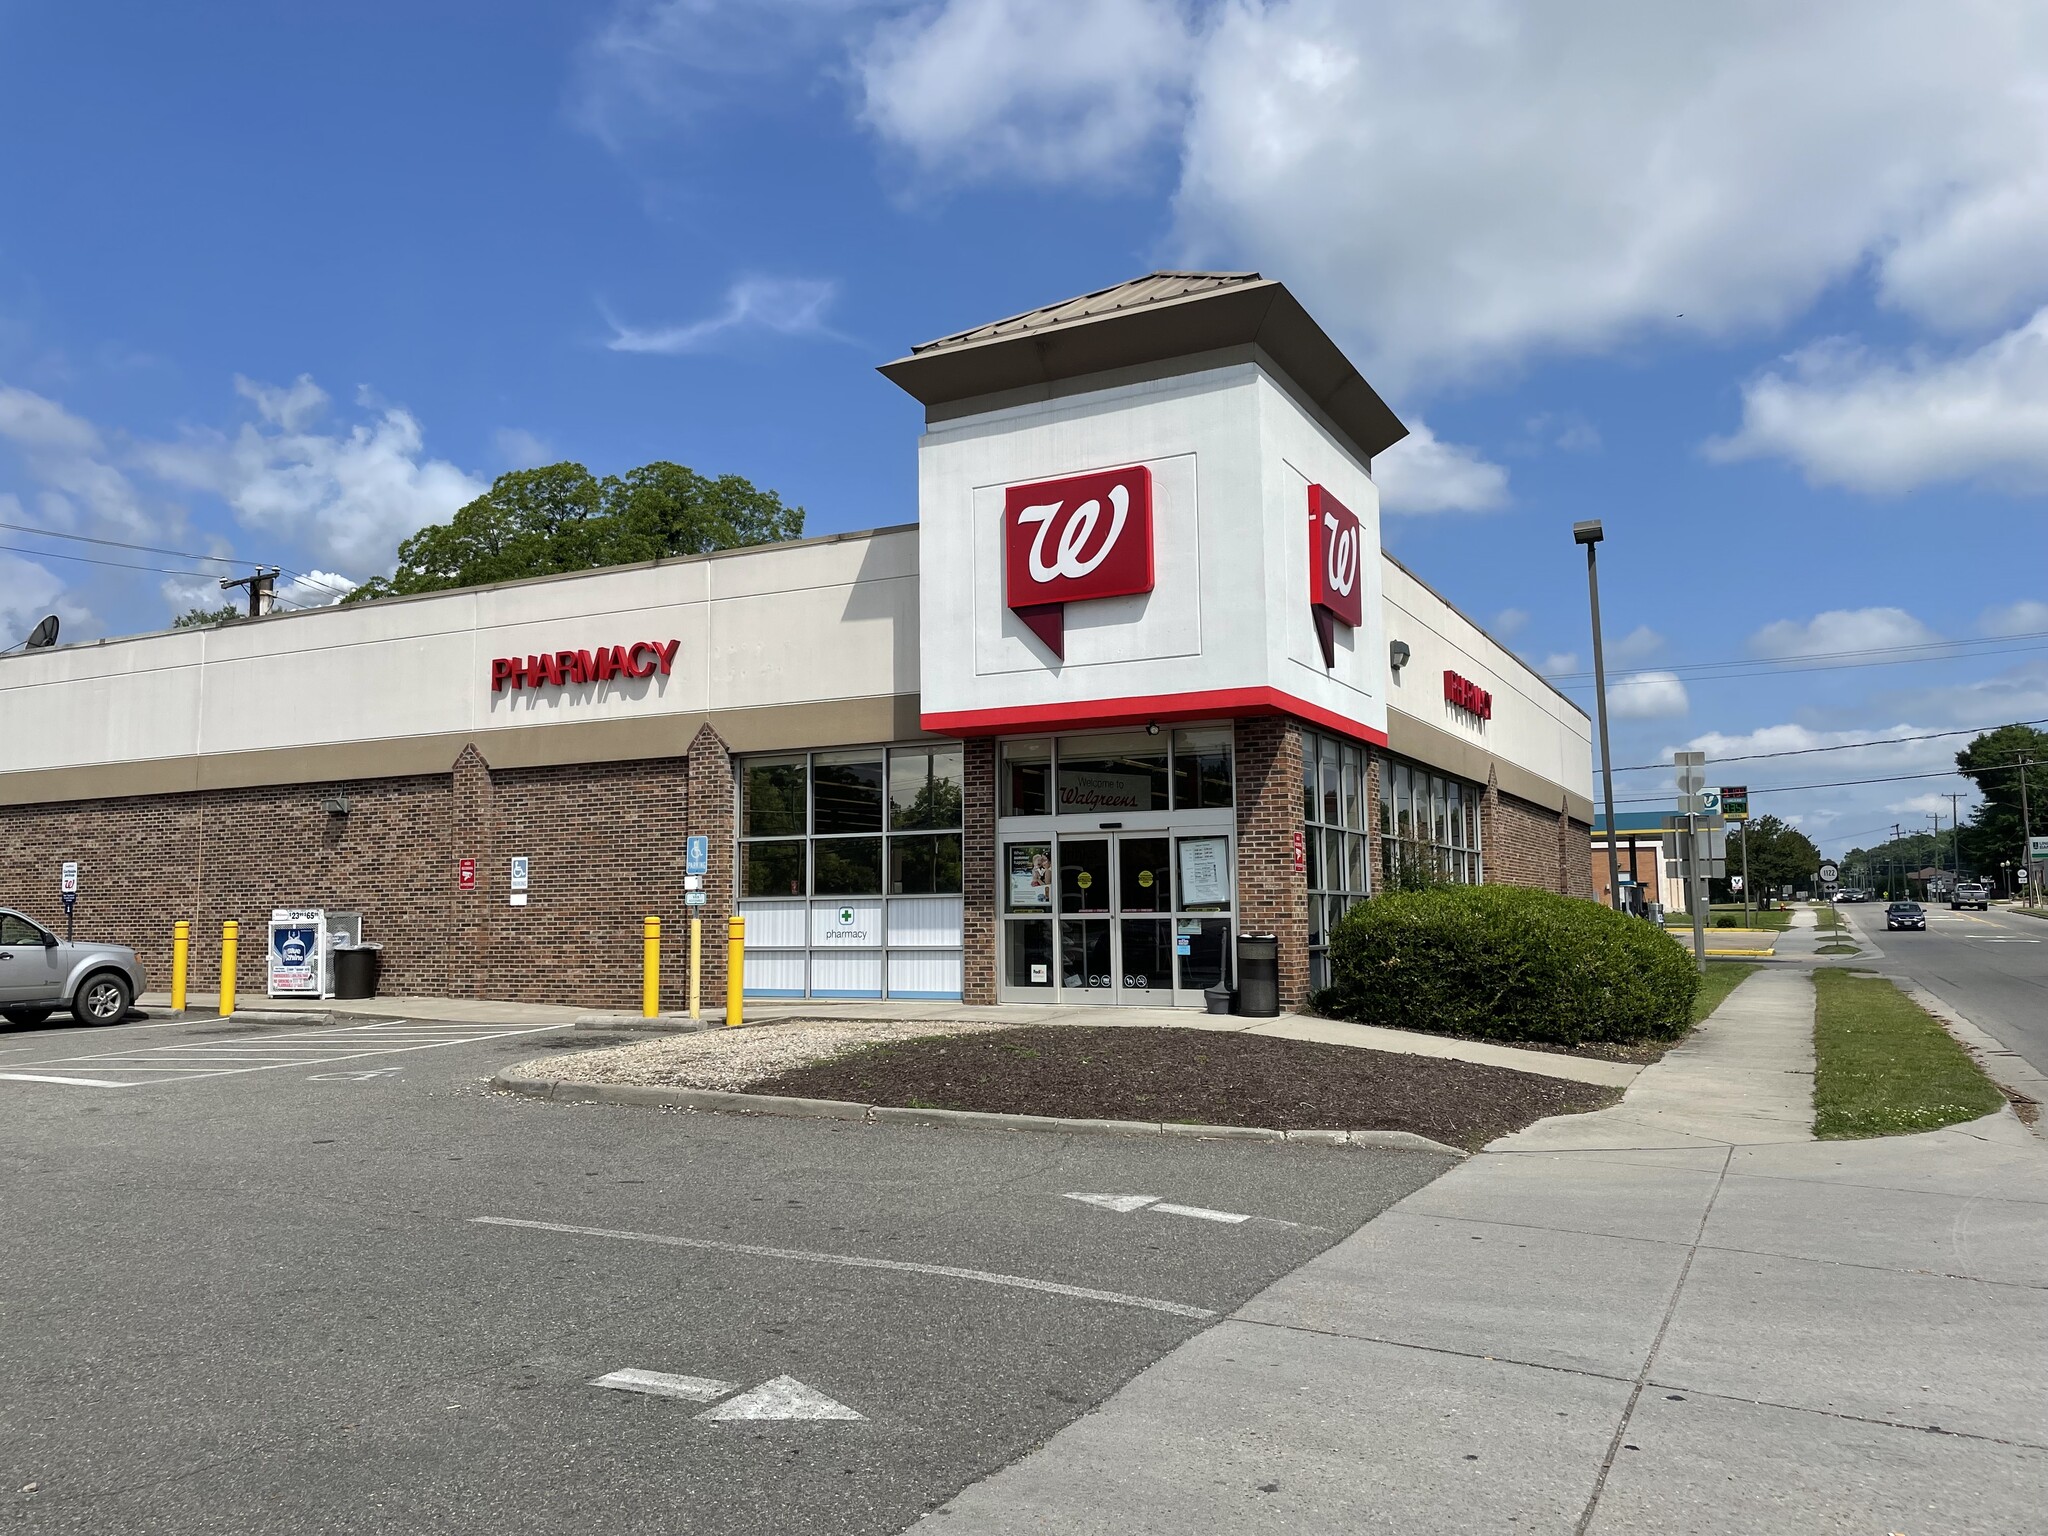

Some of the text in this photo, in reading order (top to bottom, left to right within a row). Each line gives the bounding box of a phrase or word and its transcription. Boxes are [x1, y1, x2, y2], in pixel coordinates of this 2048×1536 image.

[1017, 484, 1130, 583] W
[1324, 511, 1357, 597] W
[491, 639, 681, 692] PHARMACY
[1078, 777, 1125, 790] Welcome to
[1059, 786, 1138, 811] Walgreens
[687, 861, 706, 869] PARKING
[1823, 869, 1836, 877] 1122
[826, 929, 868, 941] pharmacy
